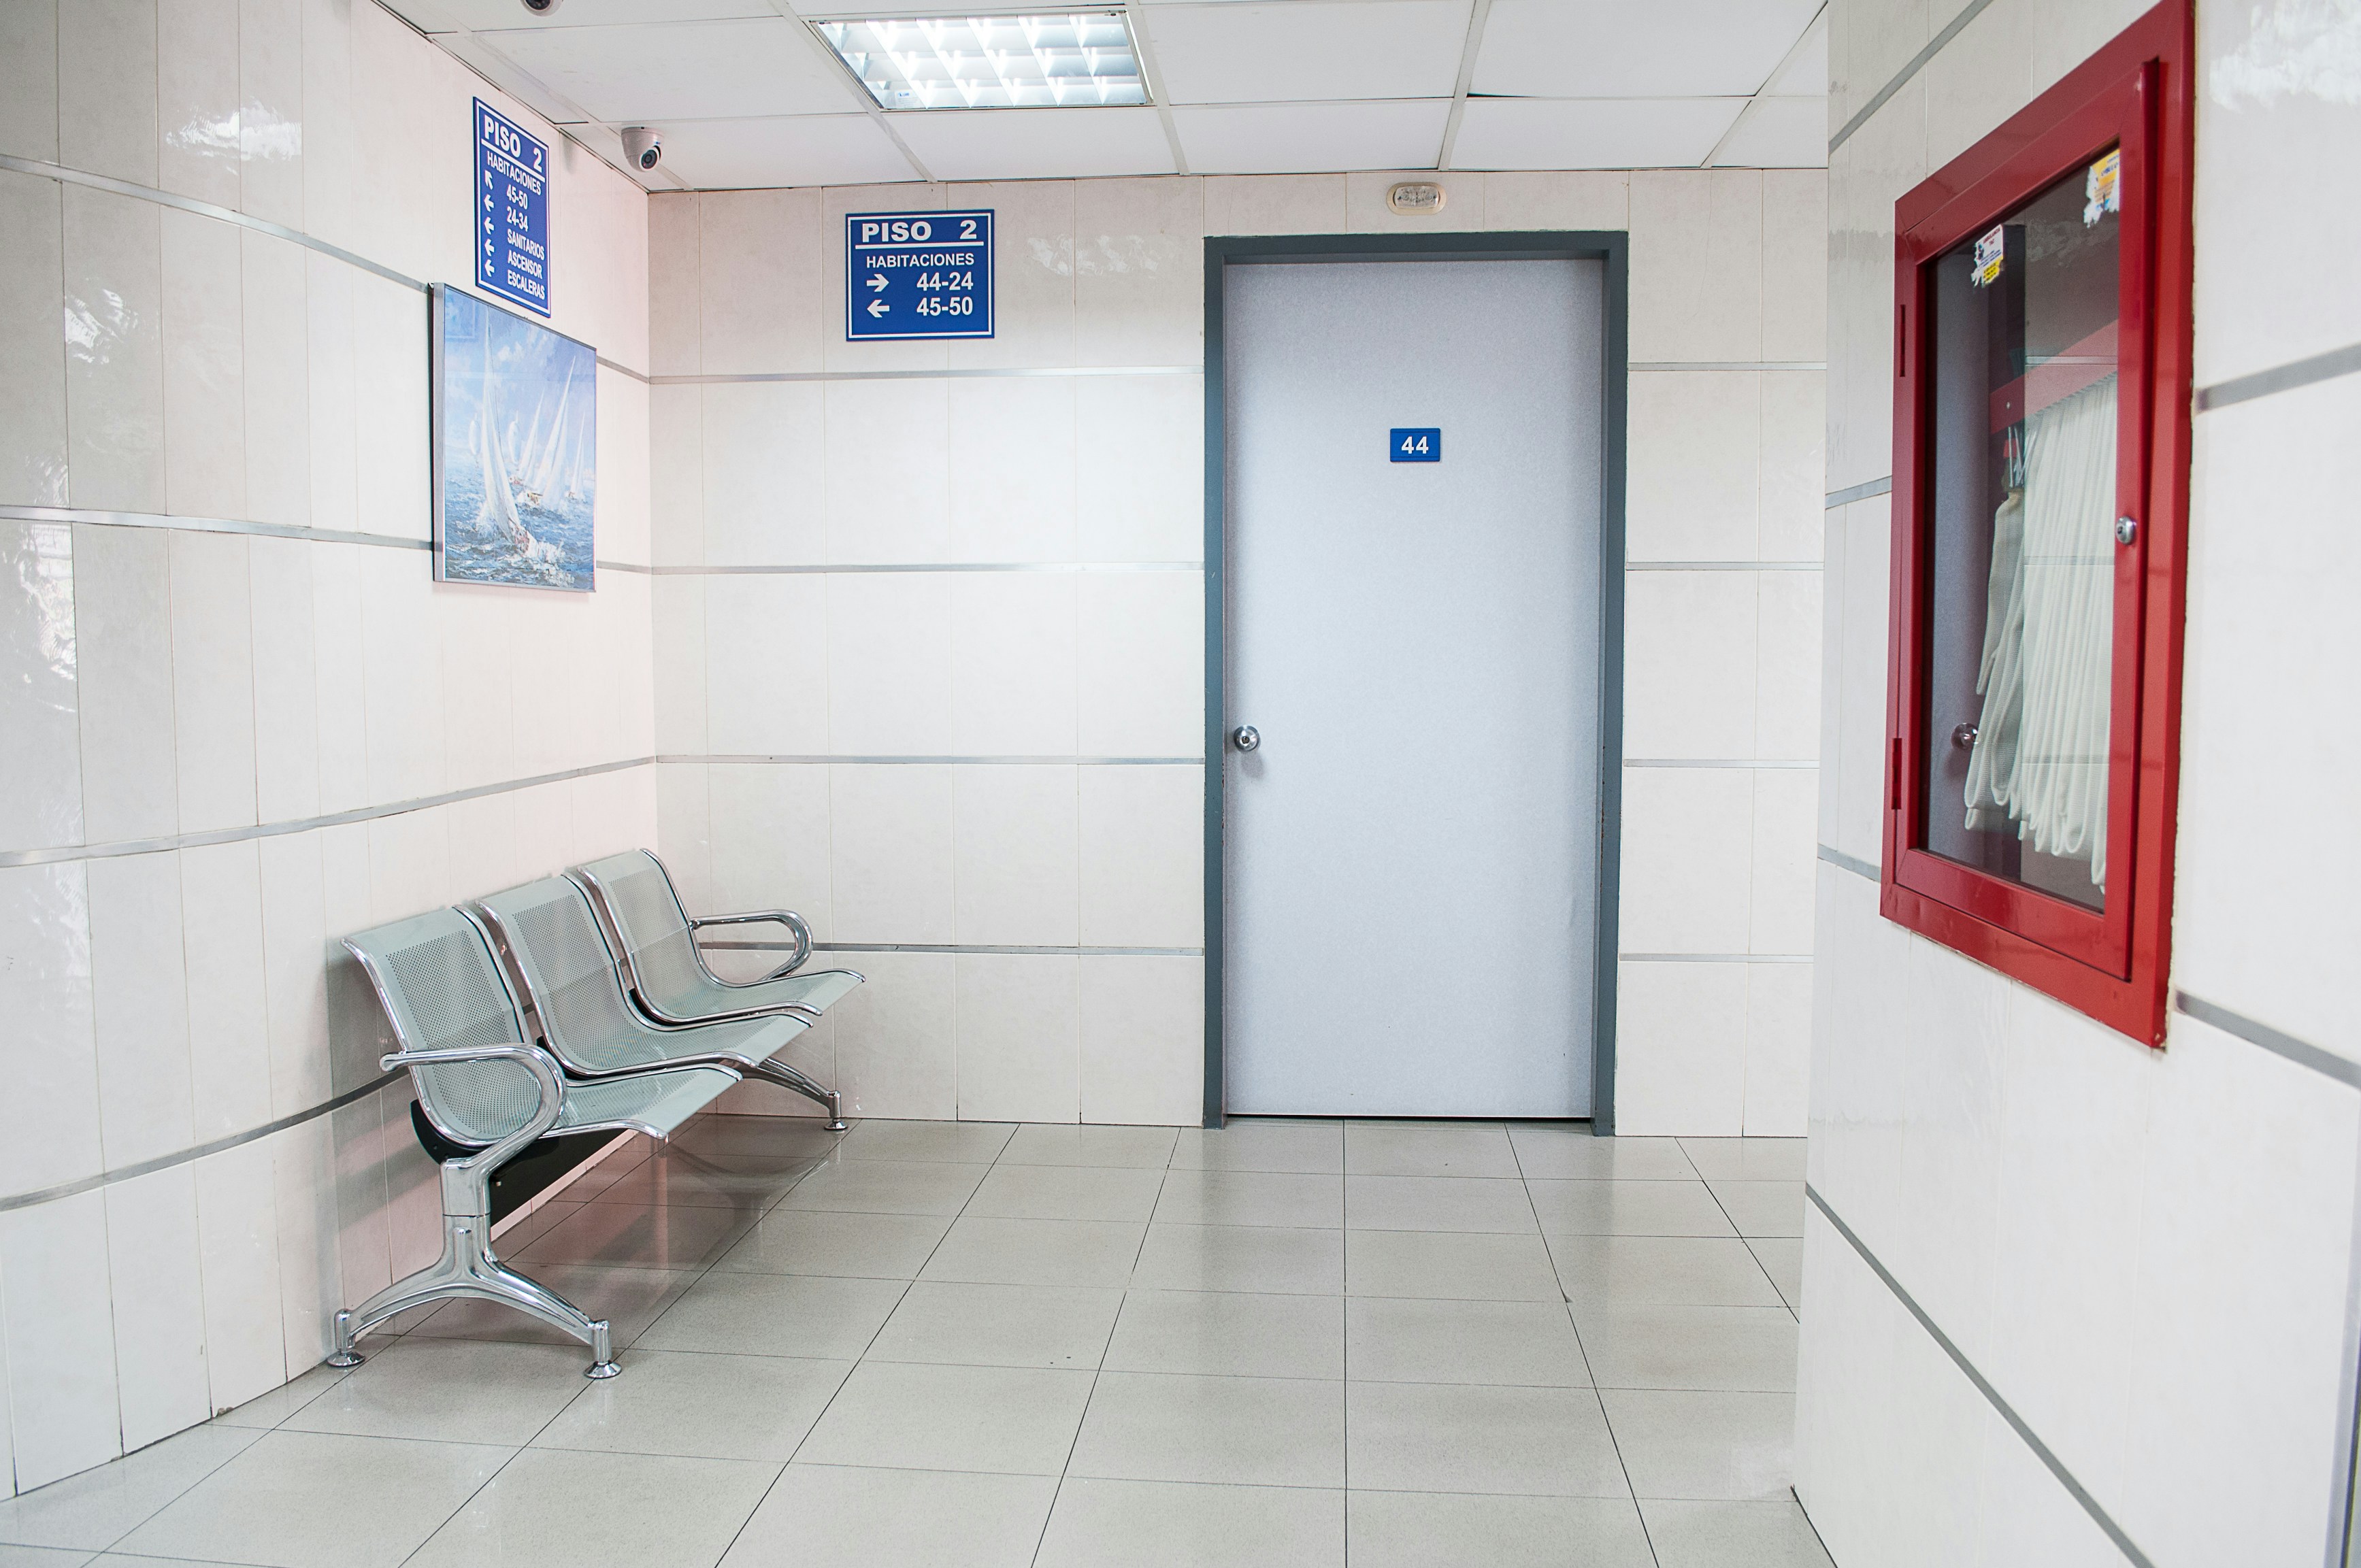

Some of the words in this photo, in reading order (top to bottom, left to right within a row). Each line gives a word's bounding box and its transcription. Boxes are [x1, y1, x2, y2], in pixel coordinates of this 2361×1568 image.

[484, 114, 521, 158] PISO
[533, 148, 542, 173] 2
[487, 150, 542, 196] HABITACIONES
[507, 184, 528, 210] 45-50
[507, 205, 529, 232] 24-34
[862, 221, 931, 243] PISO
[960, 220, 977, 239] 2
[508, 228, 545, 261] SANITARIOS
[508, 249, 543, 280] ASCENSOR
[866, 252, 974, 268] HABITACIONES
[508, 269, 545, 300] ESCALERAS
[917, 271, 974, 291] 44-24
[917, 297, 973, 316] 45-50
[1401, 436, 1429, 454] 44
